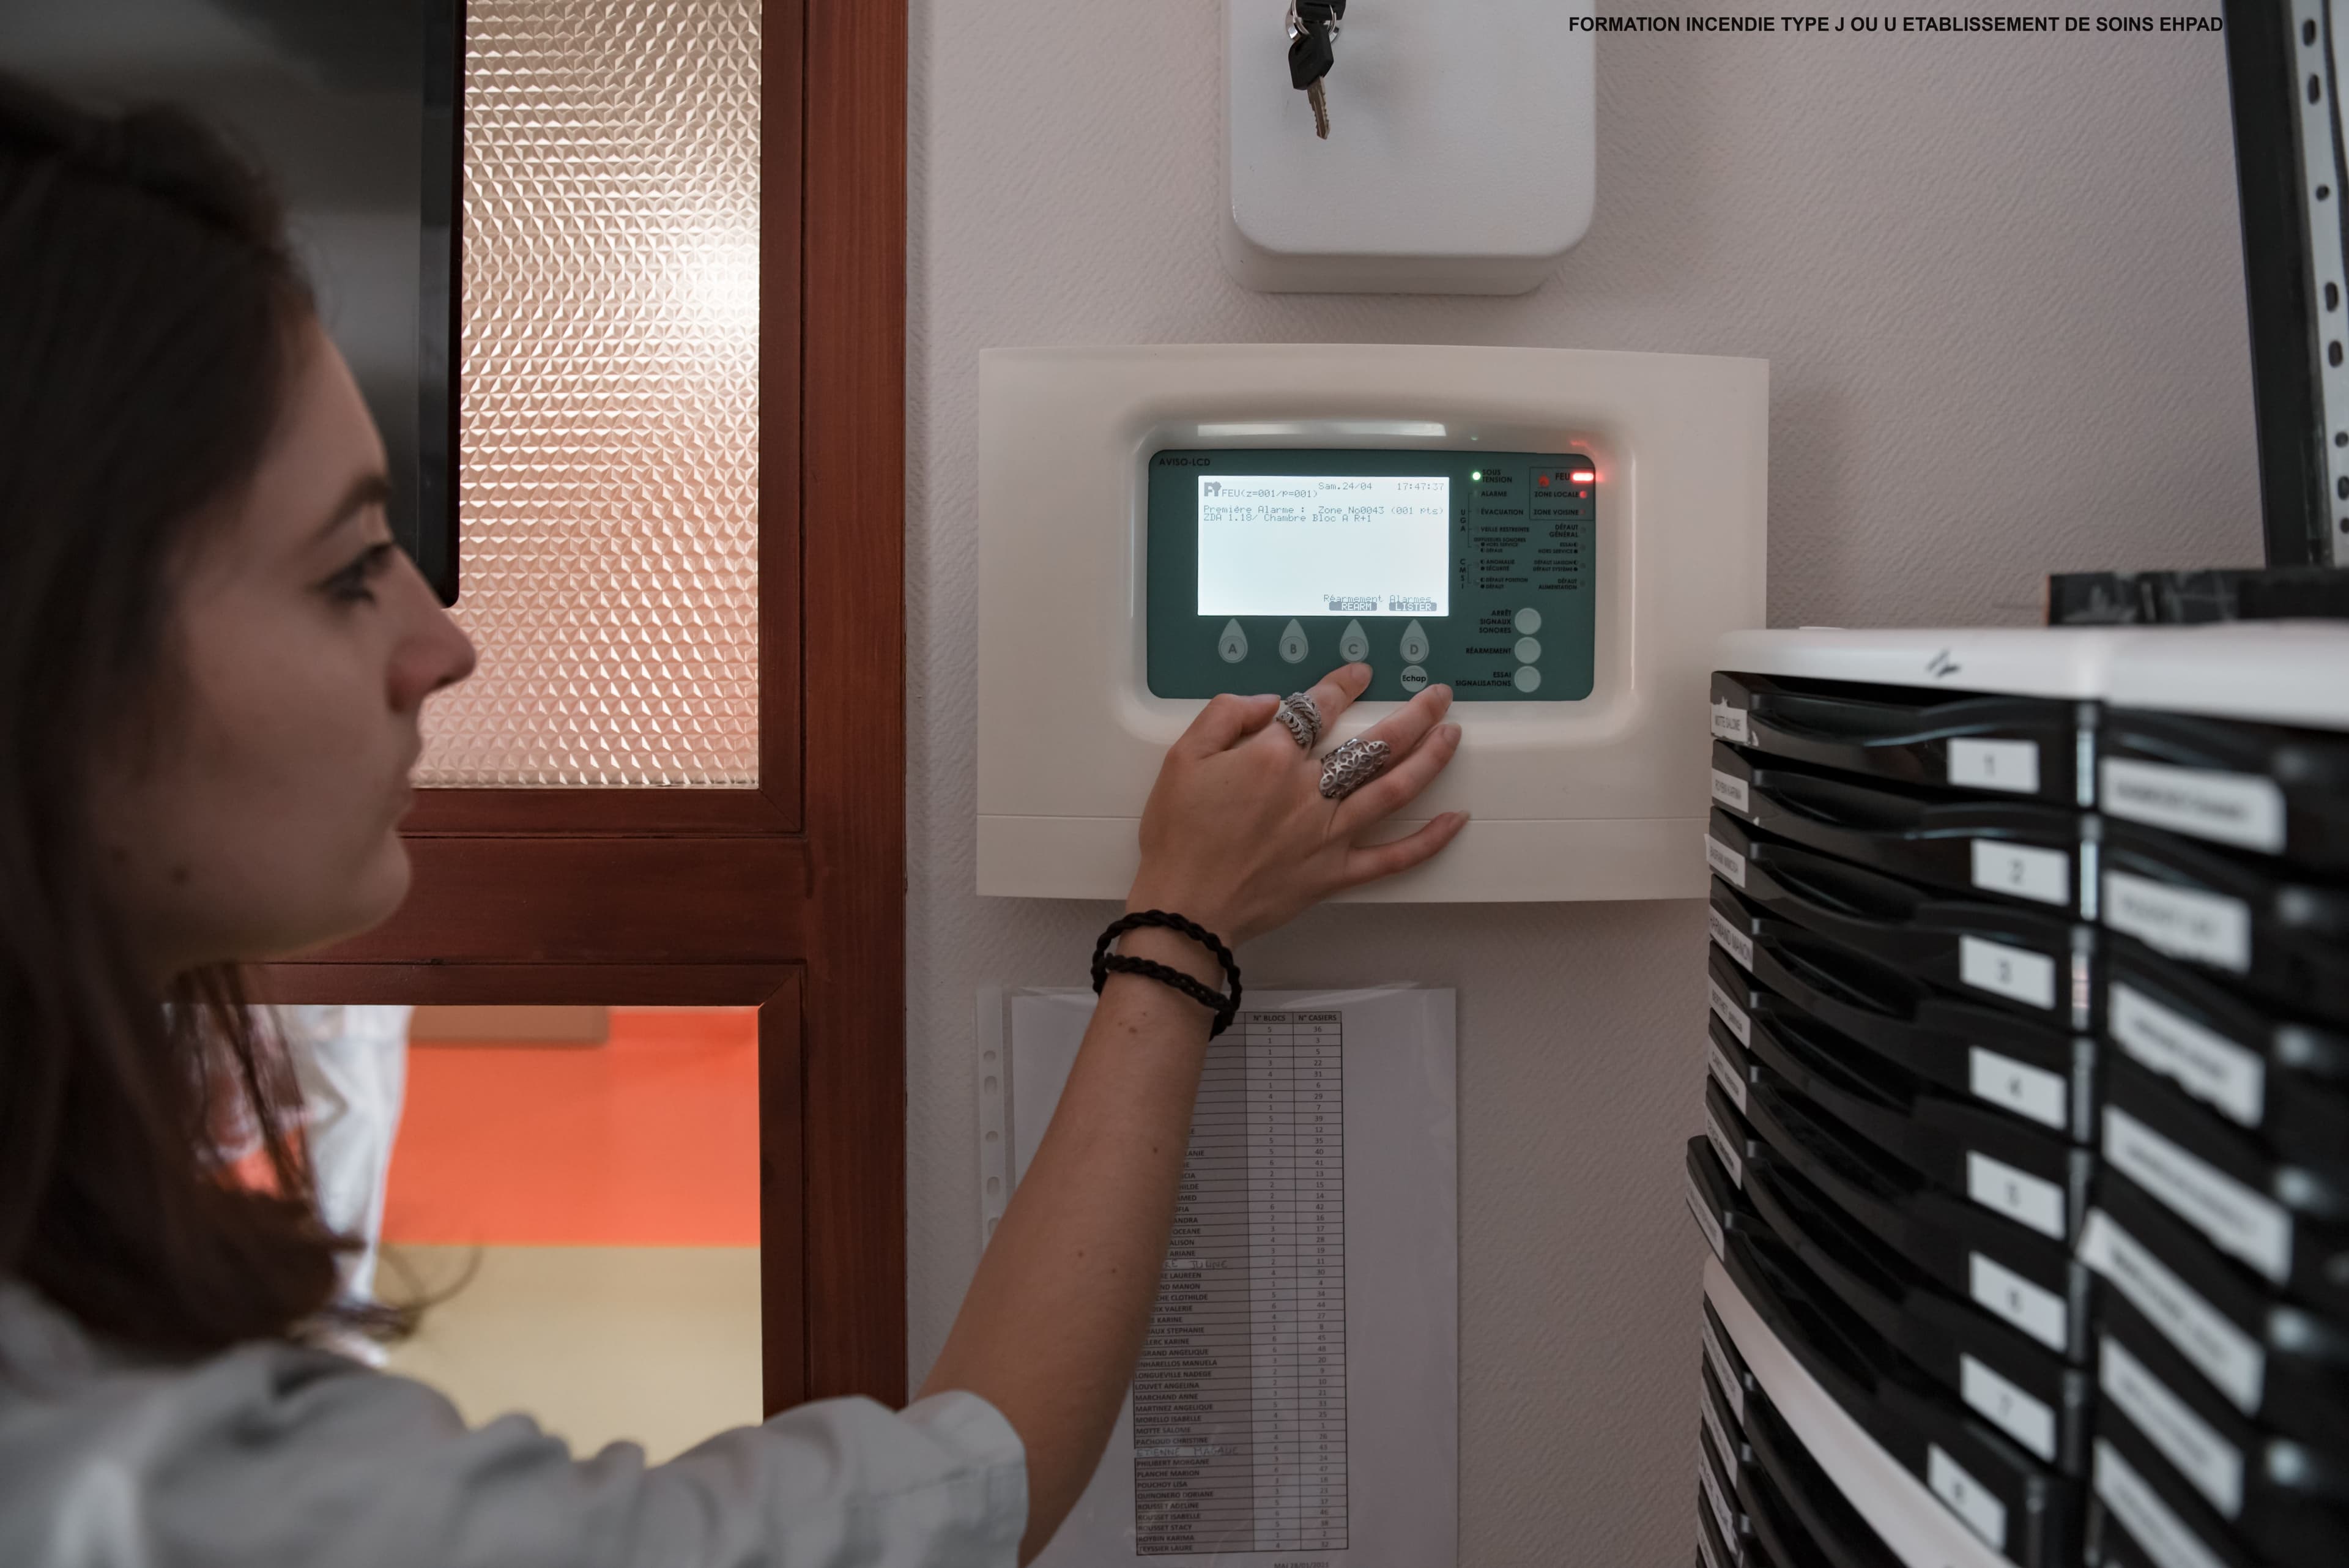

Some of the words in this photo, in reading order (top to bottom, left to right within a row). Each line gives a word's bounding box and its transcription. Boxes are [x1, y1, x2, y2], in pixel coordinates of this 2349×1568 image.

[1324, 594, 1384, 603] Réarmement
[1395, 603, 1431, 611] LISTER
[1228, 644, 1237, 653] A
[1291, 644, 1297, 654] B
[1348, 644, 1358, 654] C
[1410, 645, 1418, 654] D
[2010, 858, 2024, 885] 2
[1998, 957, 2012, 984] 3
